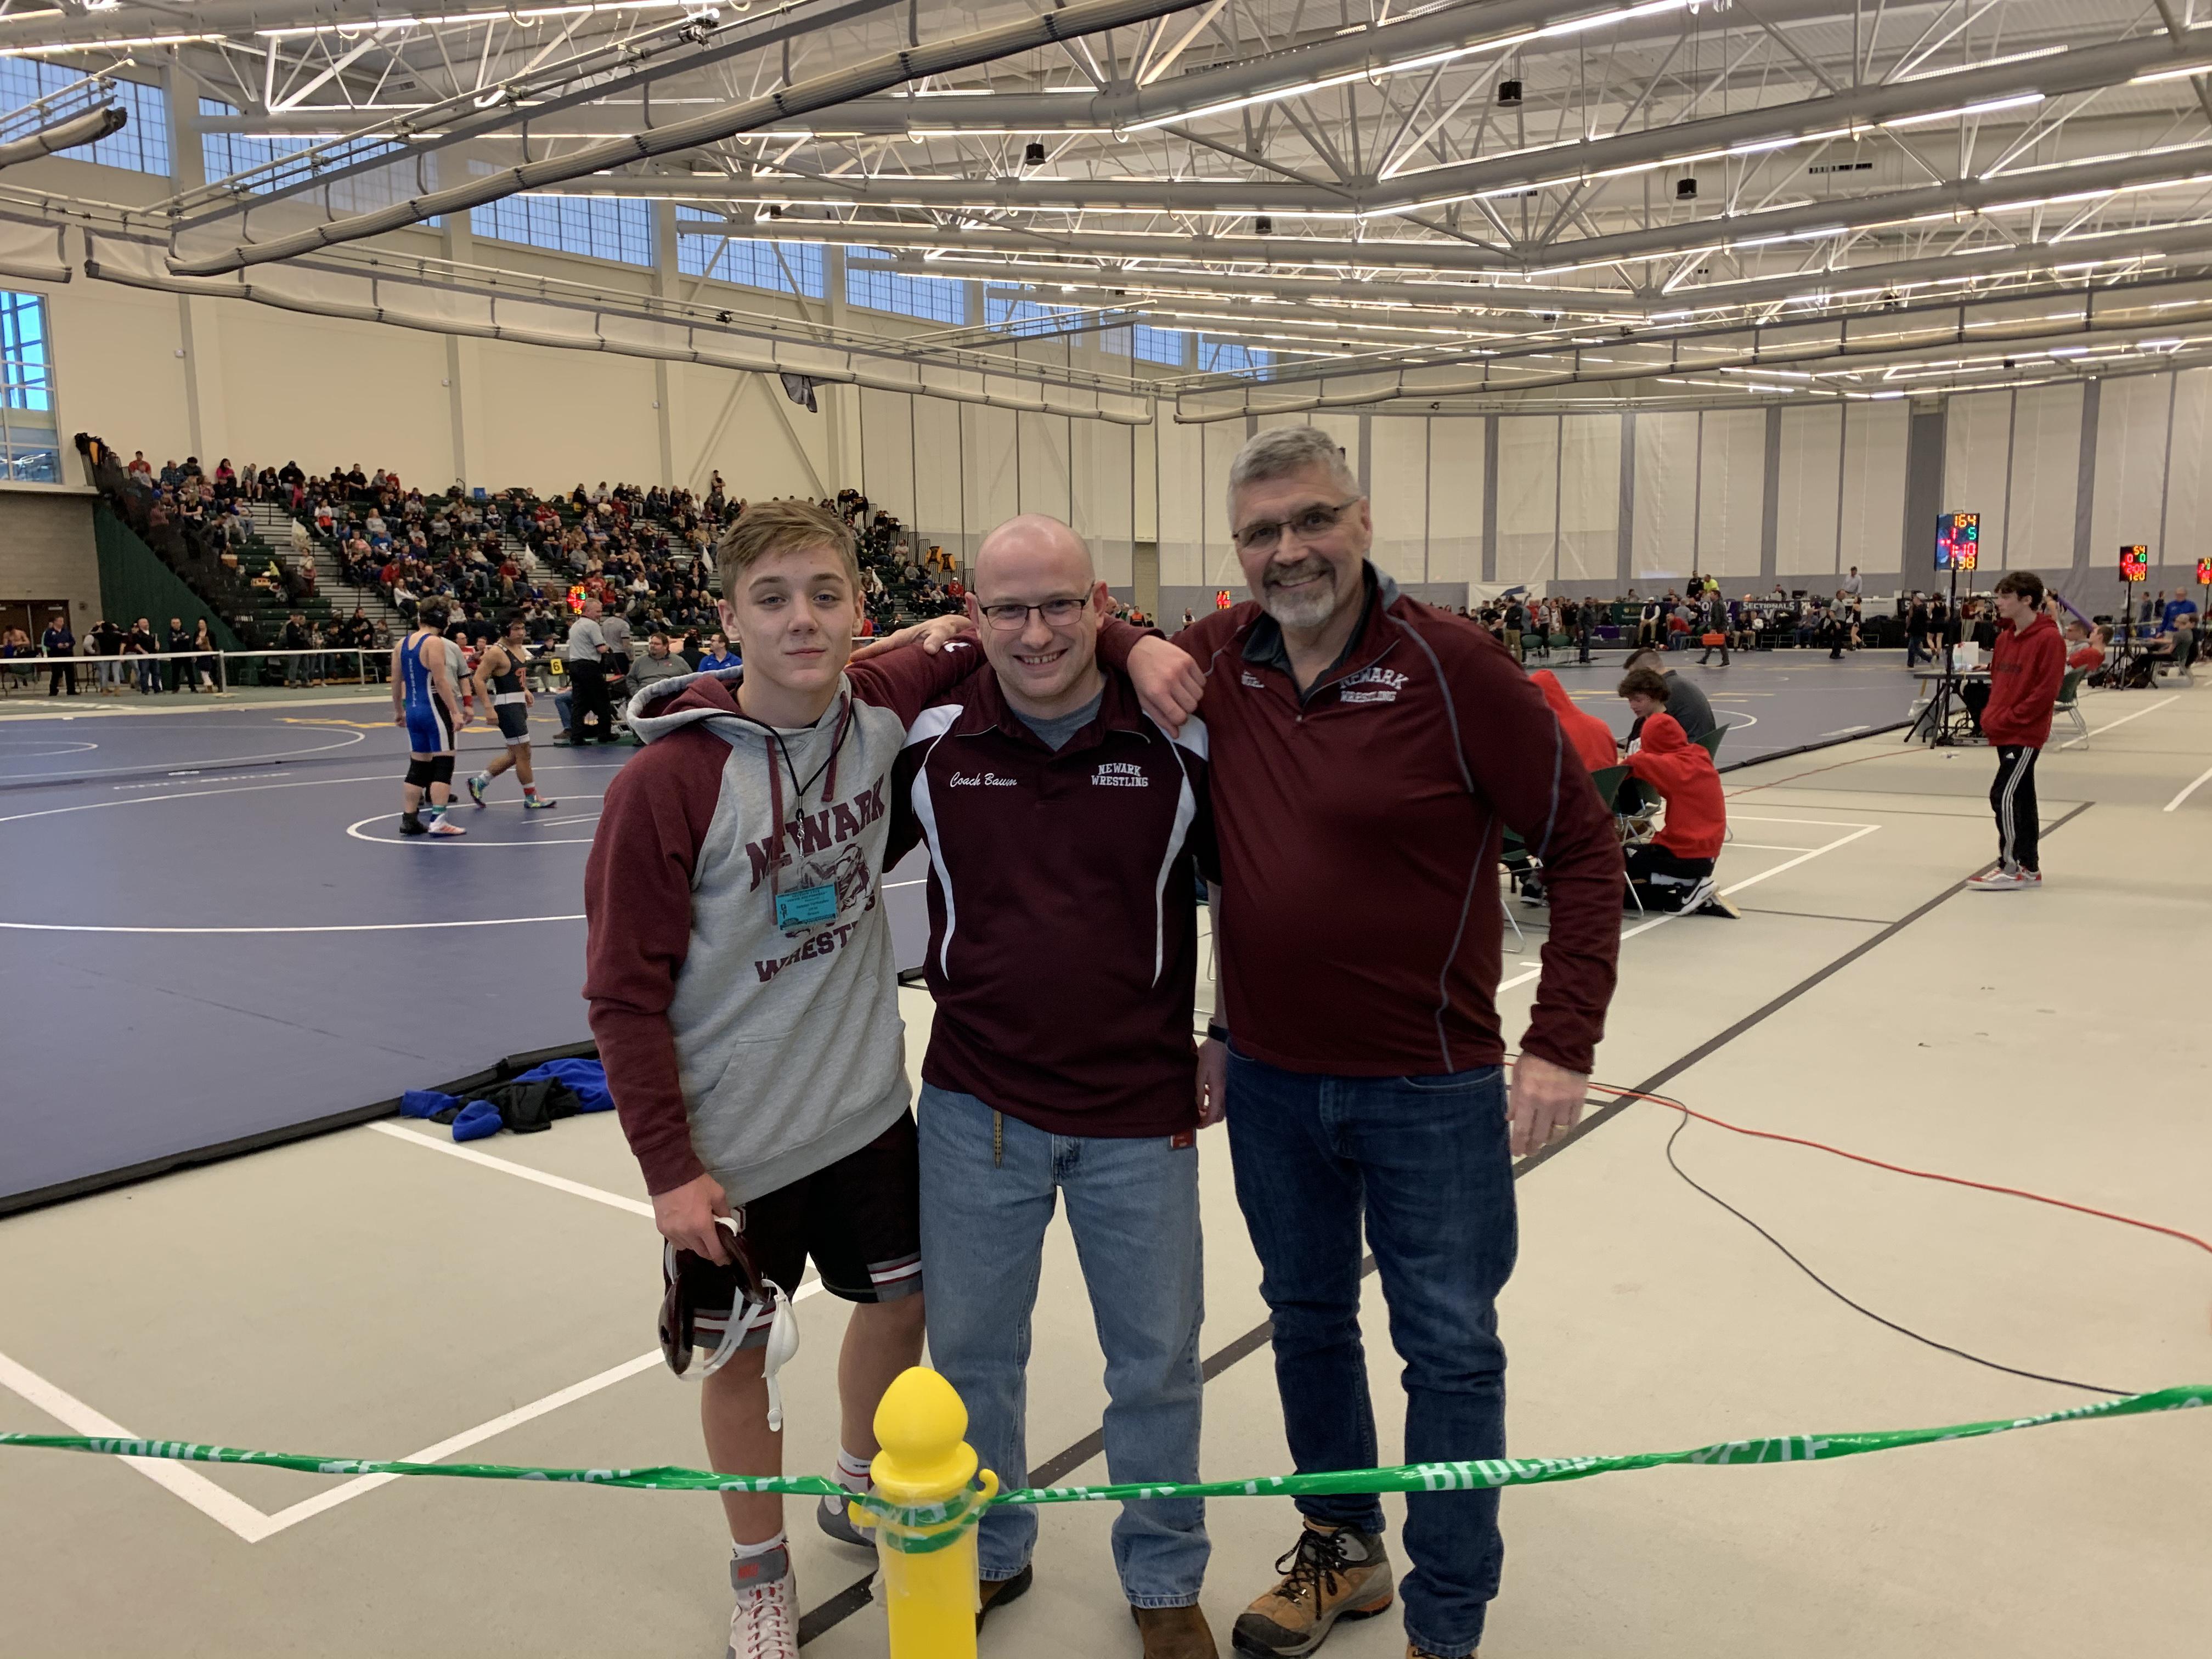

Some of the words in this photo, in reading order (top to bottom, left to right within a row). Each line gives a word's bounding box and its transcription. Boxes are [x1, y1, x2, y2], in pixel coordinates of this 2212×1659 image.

[1954, 514, 1977, 528] 164
[1951, 527, 1957, 540] 1
[1968, 527, 1976, 540] 5
[1951, 542, 1976, 556] 1:10
[1951, 556, 1976, 569] 138
[2127, 553, 2134, 563] 0
[2140, 554, 2146, 562] 0
[2126, 563, 2146, 573] 2:00
[2129, 572, 2146, 582] 120
[1742, 601, 1795, 611] SECTIONALS
[552, 661, 561, 672] 6
[1098, 763, 1142, 777] NEWARK
[950, 771, 981, 788] Coach
[984, 772, 1018, 787] Baum
[1091, 774, 1149, 787] WRESTLING
[745, 773, 885, 892] NWARK
